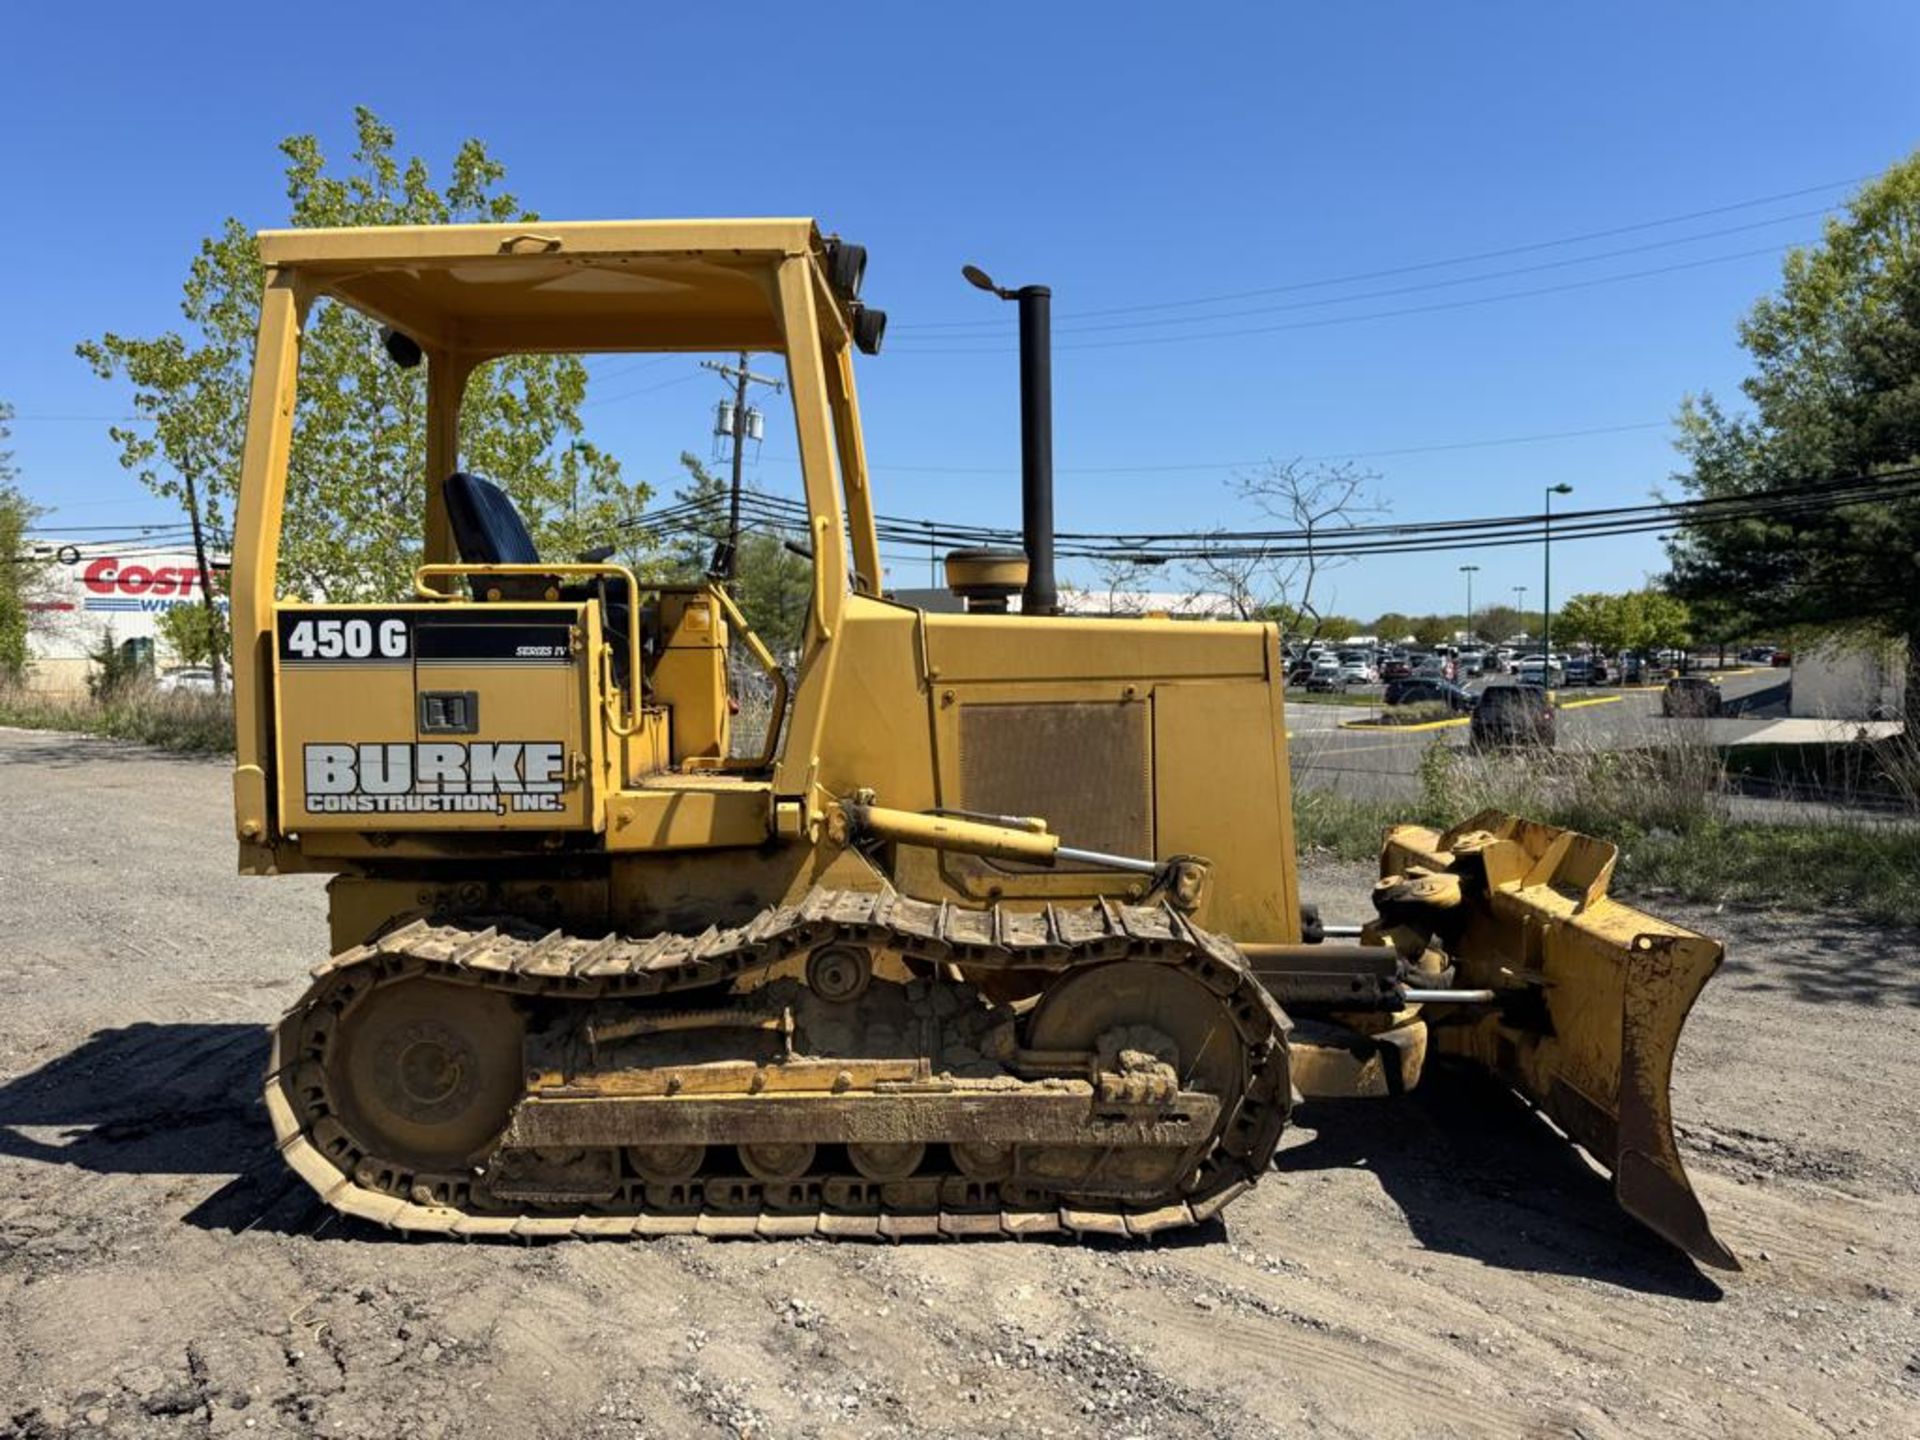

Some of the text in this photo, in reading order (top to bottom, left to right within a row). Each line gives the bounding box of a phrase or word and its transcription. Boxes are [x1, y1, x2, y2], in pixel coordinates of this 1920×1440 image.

[84, 556, 229, 597] COST
[288, 619, 407, 658] 450 G
[303, 742, 564, 794] BURKE
[306, 793, 566, 816] CONSTRUCTION, INC.
